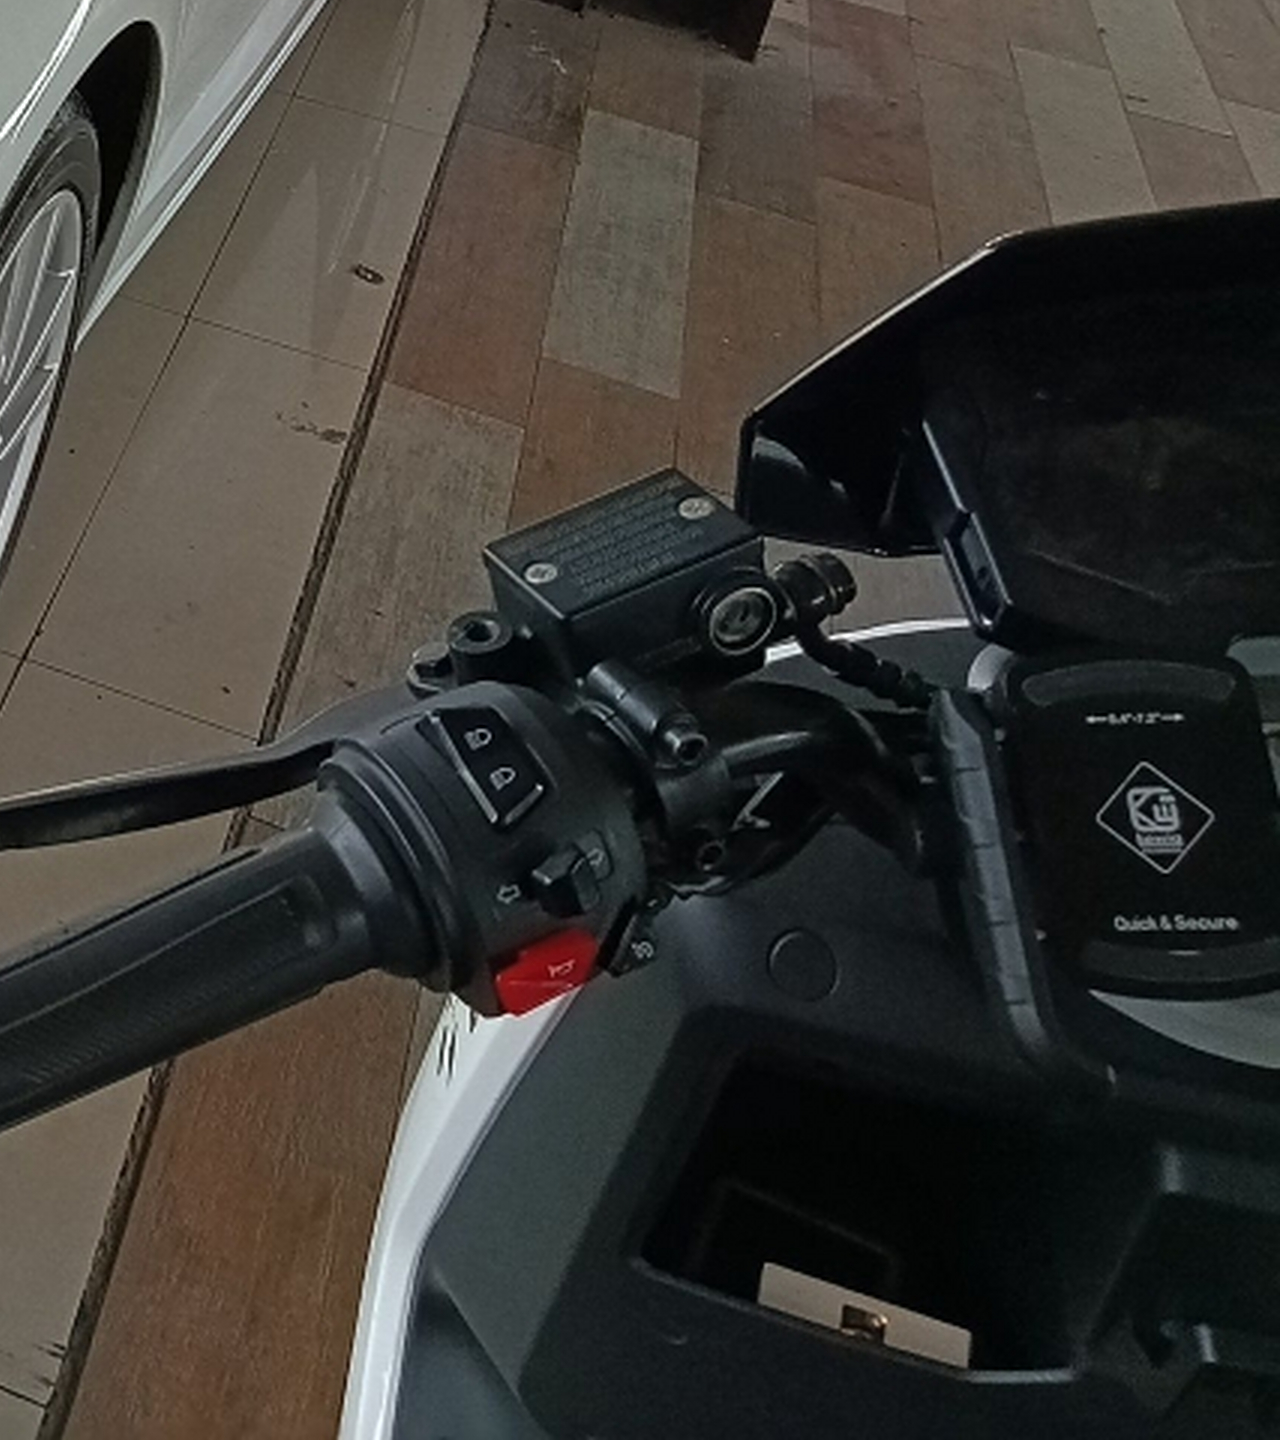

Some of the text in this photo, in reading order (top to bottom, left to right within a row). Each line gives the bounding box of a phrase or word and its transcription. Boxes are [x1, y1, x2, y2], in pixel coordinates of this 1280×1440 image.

[1114, 914, 1239, 931] Quick & Secure
